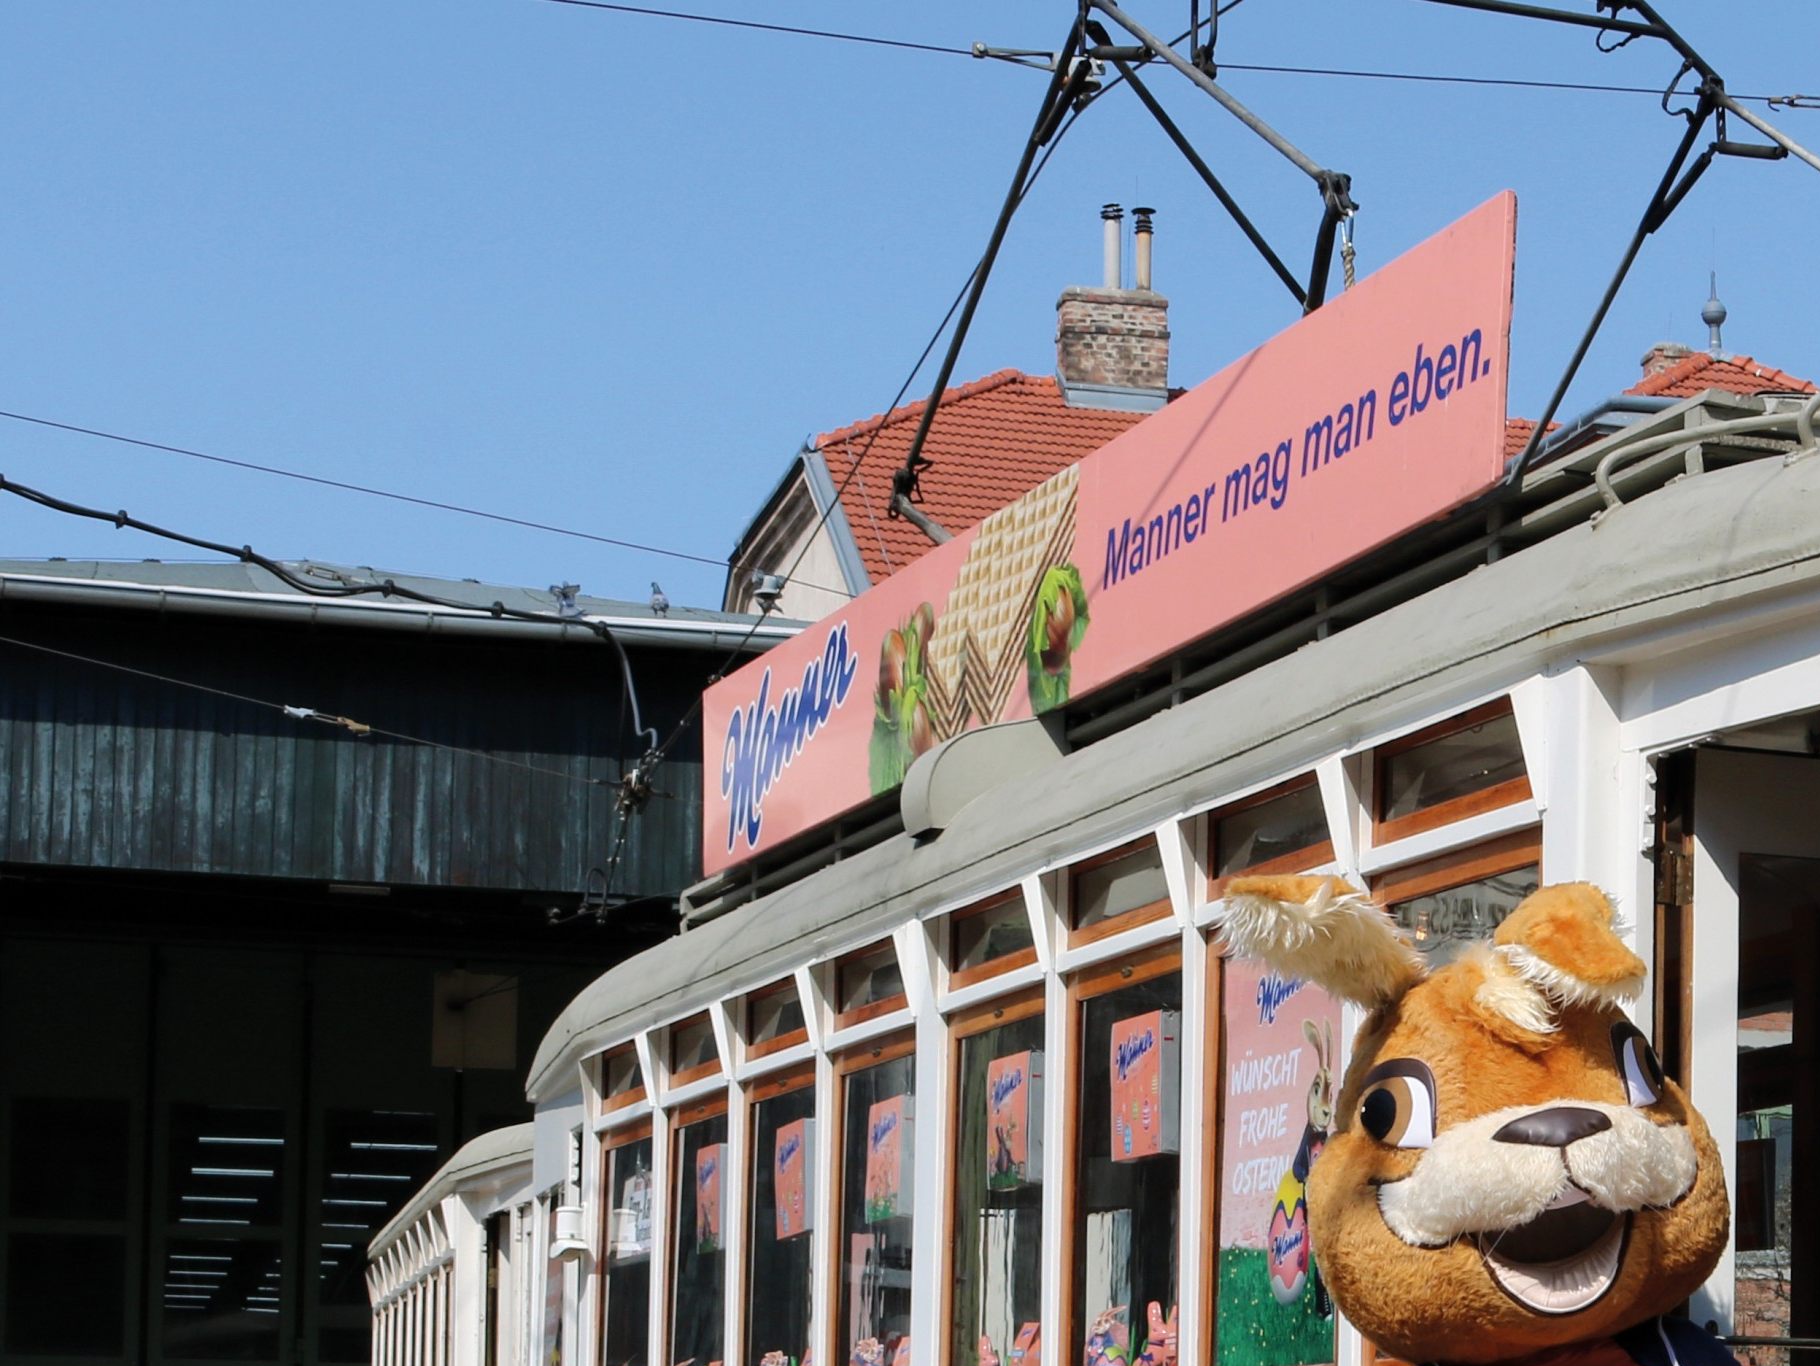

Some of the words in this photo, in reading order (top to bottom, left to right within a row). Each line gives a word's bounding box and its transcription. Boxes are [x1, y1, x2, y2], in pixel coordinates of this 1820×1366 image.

[1102, 483, 1216, 590] Manner
[1221, 437, 1293, 511] mag
[1299, 388, 1377, 479] man
[1387, 327, 1492, 427] eben.
[720, 619, 859, 855] Manner
[1231, 1047, 1302, 1097] WÜNSCHT
[1239, 1103, 1289, 1149] FROHE
